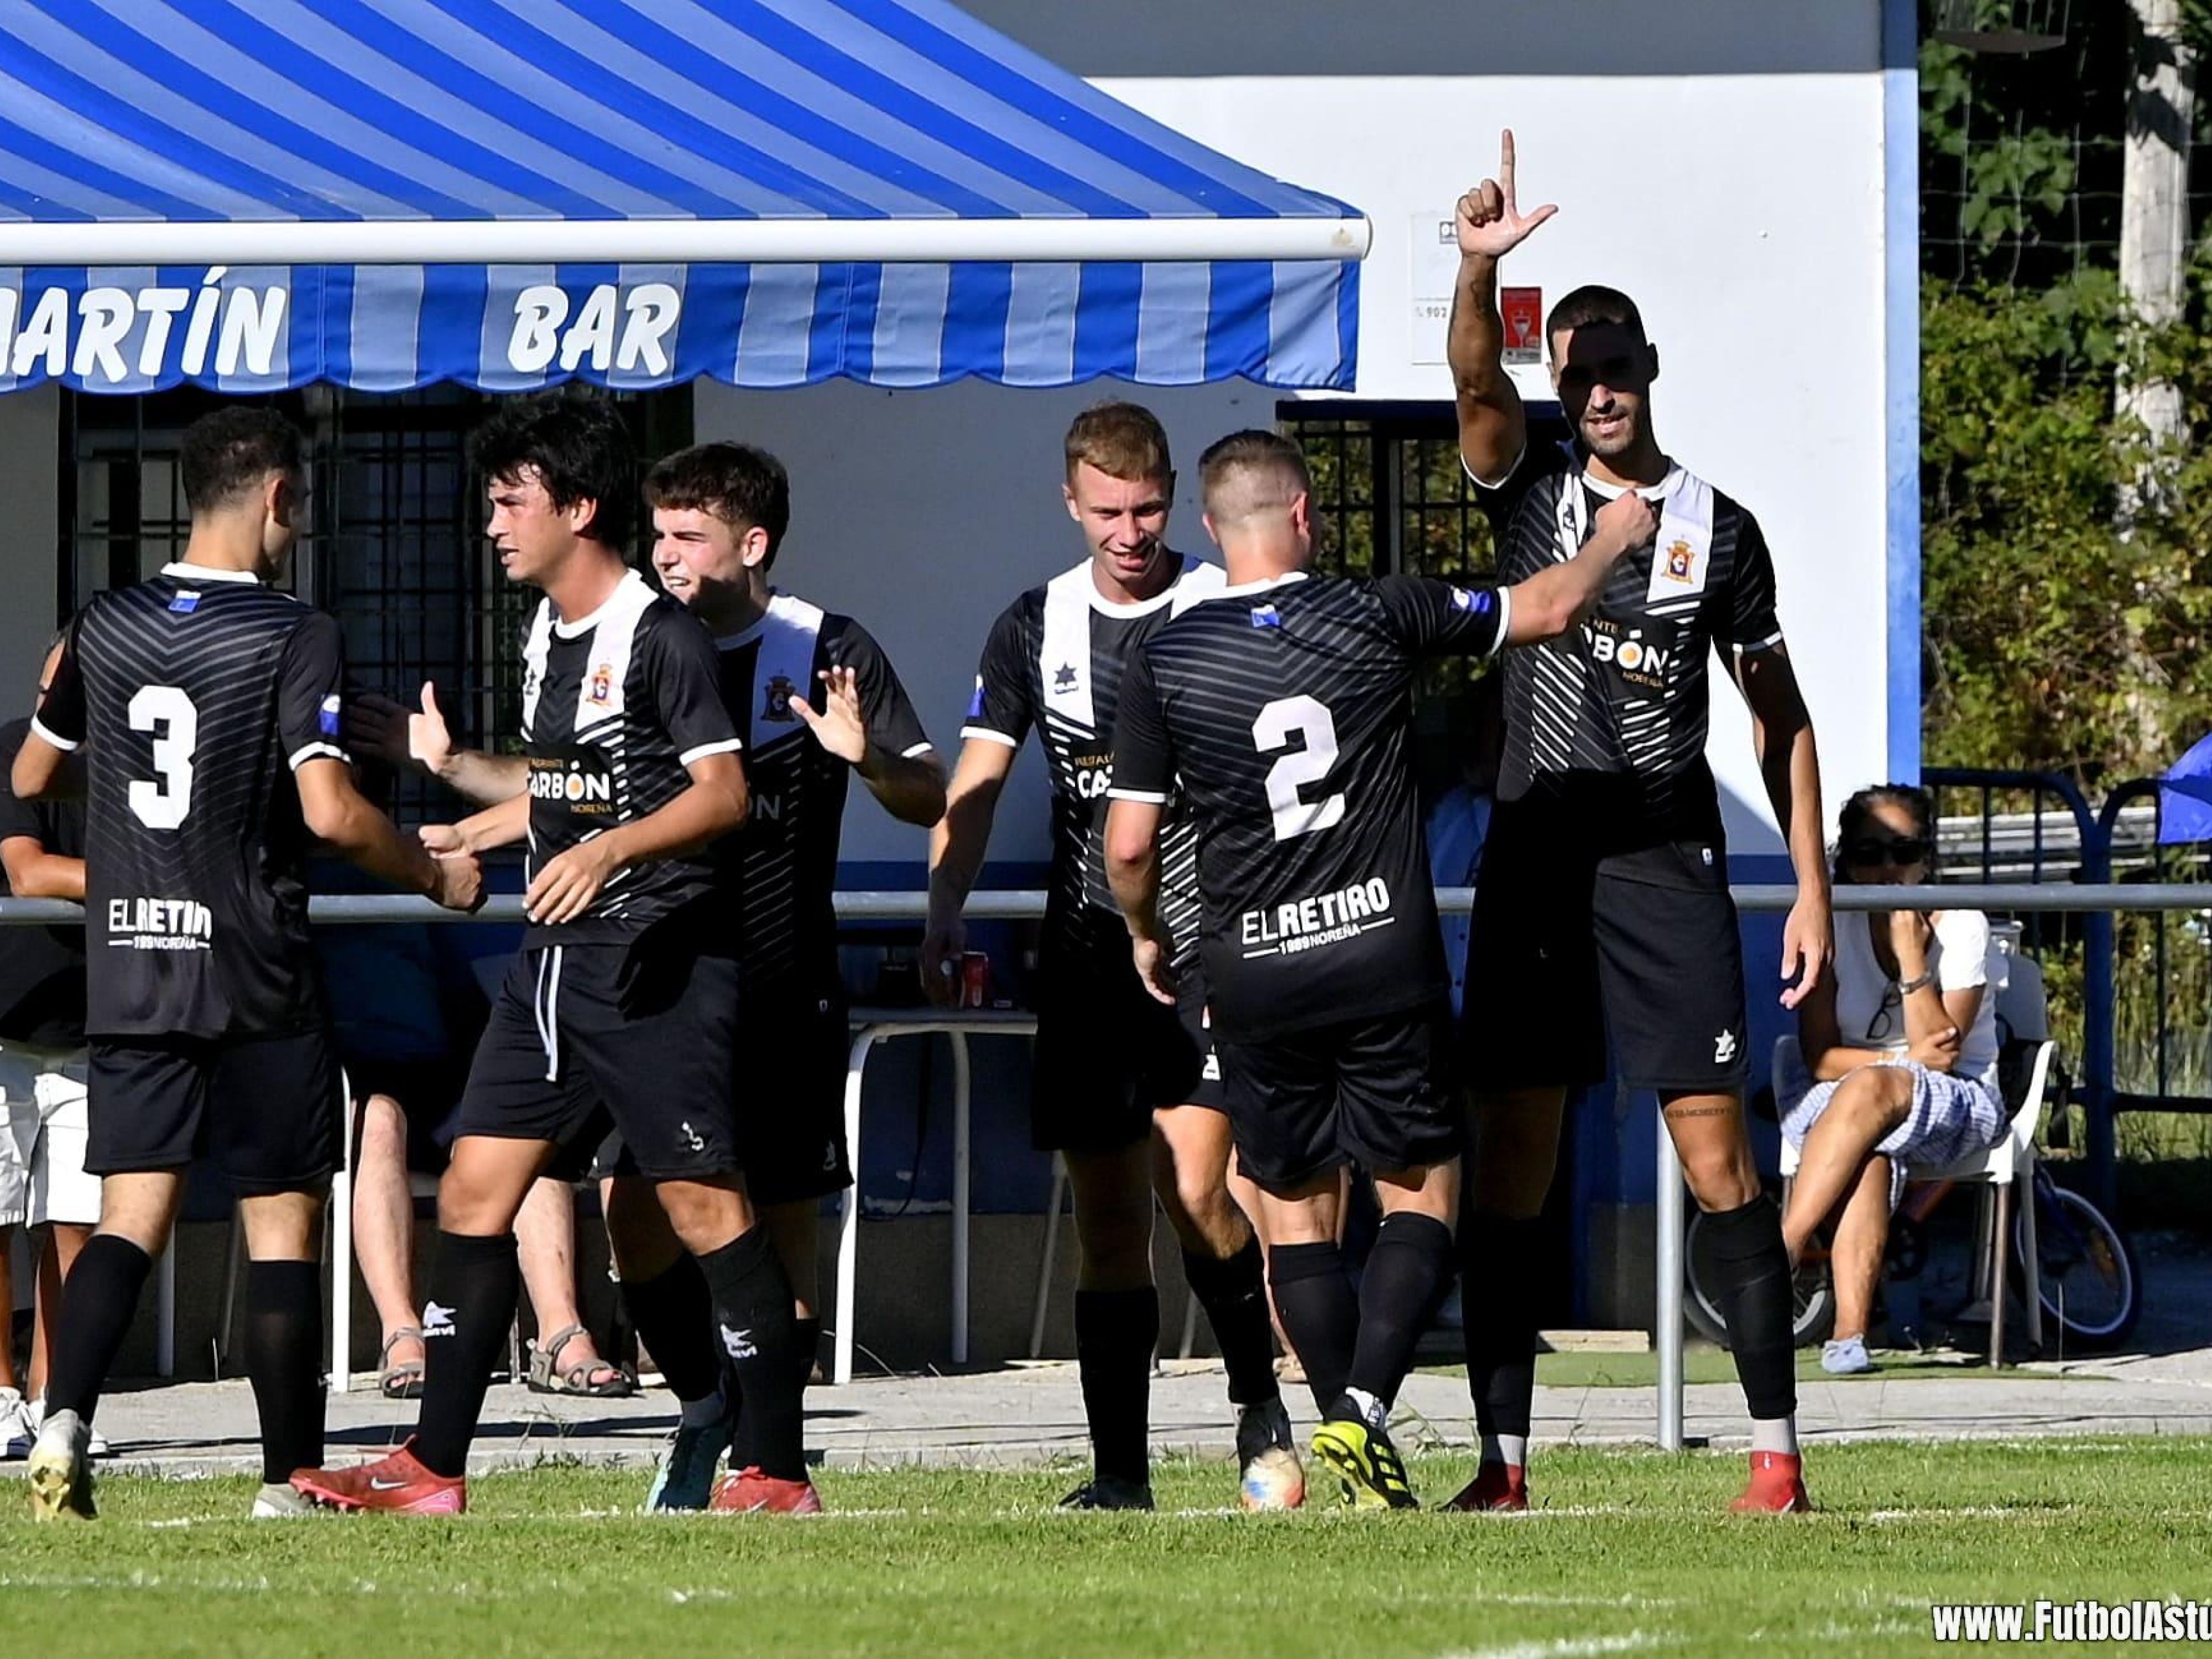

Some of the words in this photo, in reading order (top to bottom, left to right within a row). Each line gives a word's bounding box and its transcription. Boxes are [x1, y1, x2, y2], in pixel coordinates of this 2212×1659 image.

[508, 283, 680, 375] BAR
[128, 685, 197, 830] 3
[526, 760, 611, 800] ARBÓN
[1252, 695, 1345, 841] 2
